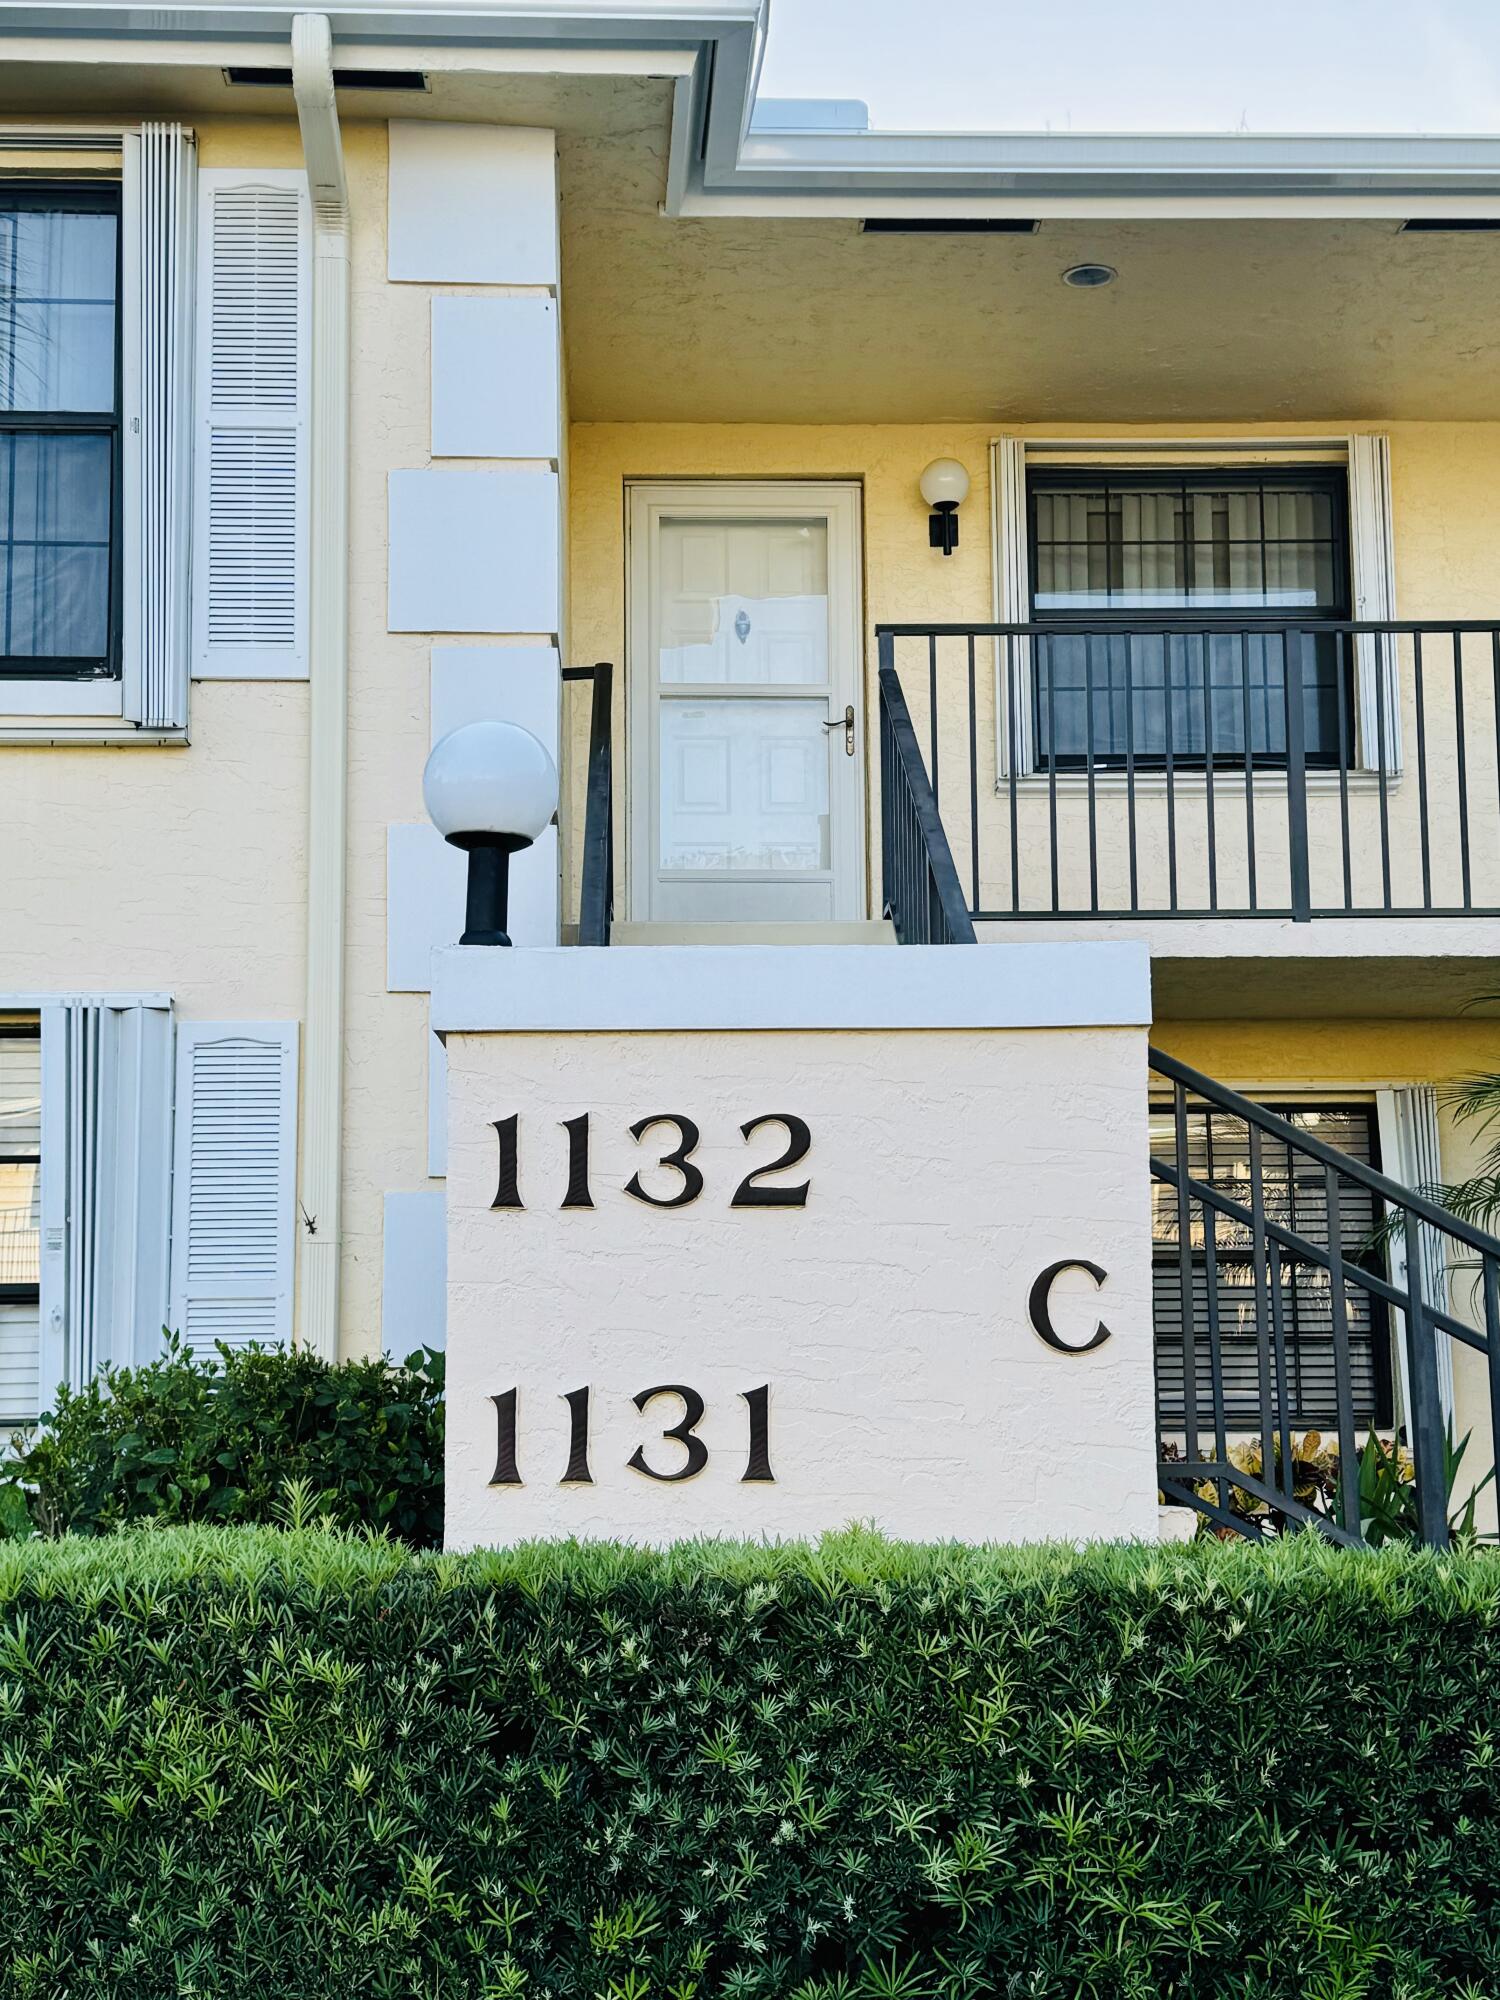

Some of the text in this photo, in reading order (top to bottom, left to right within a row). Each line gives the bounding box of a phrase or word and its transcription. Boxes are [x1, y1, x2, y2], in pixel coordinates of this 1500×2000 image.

[490, 1113, 811, 1209] 1132
[1028, 1259, 1112, 1354] C
[488, 1384, 775, 1486] 1131
